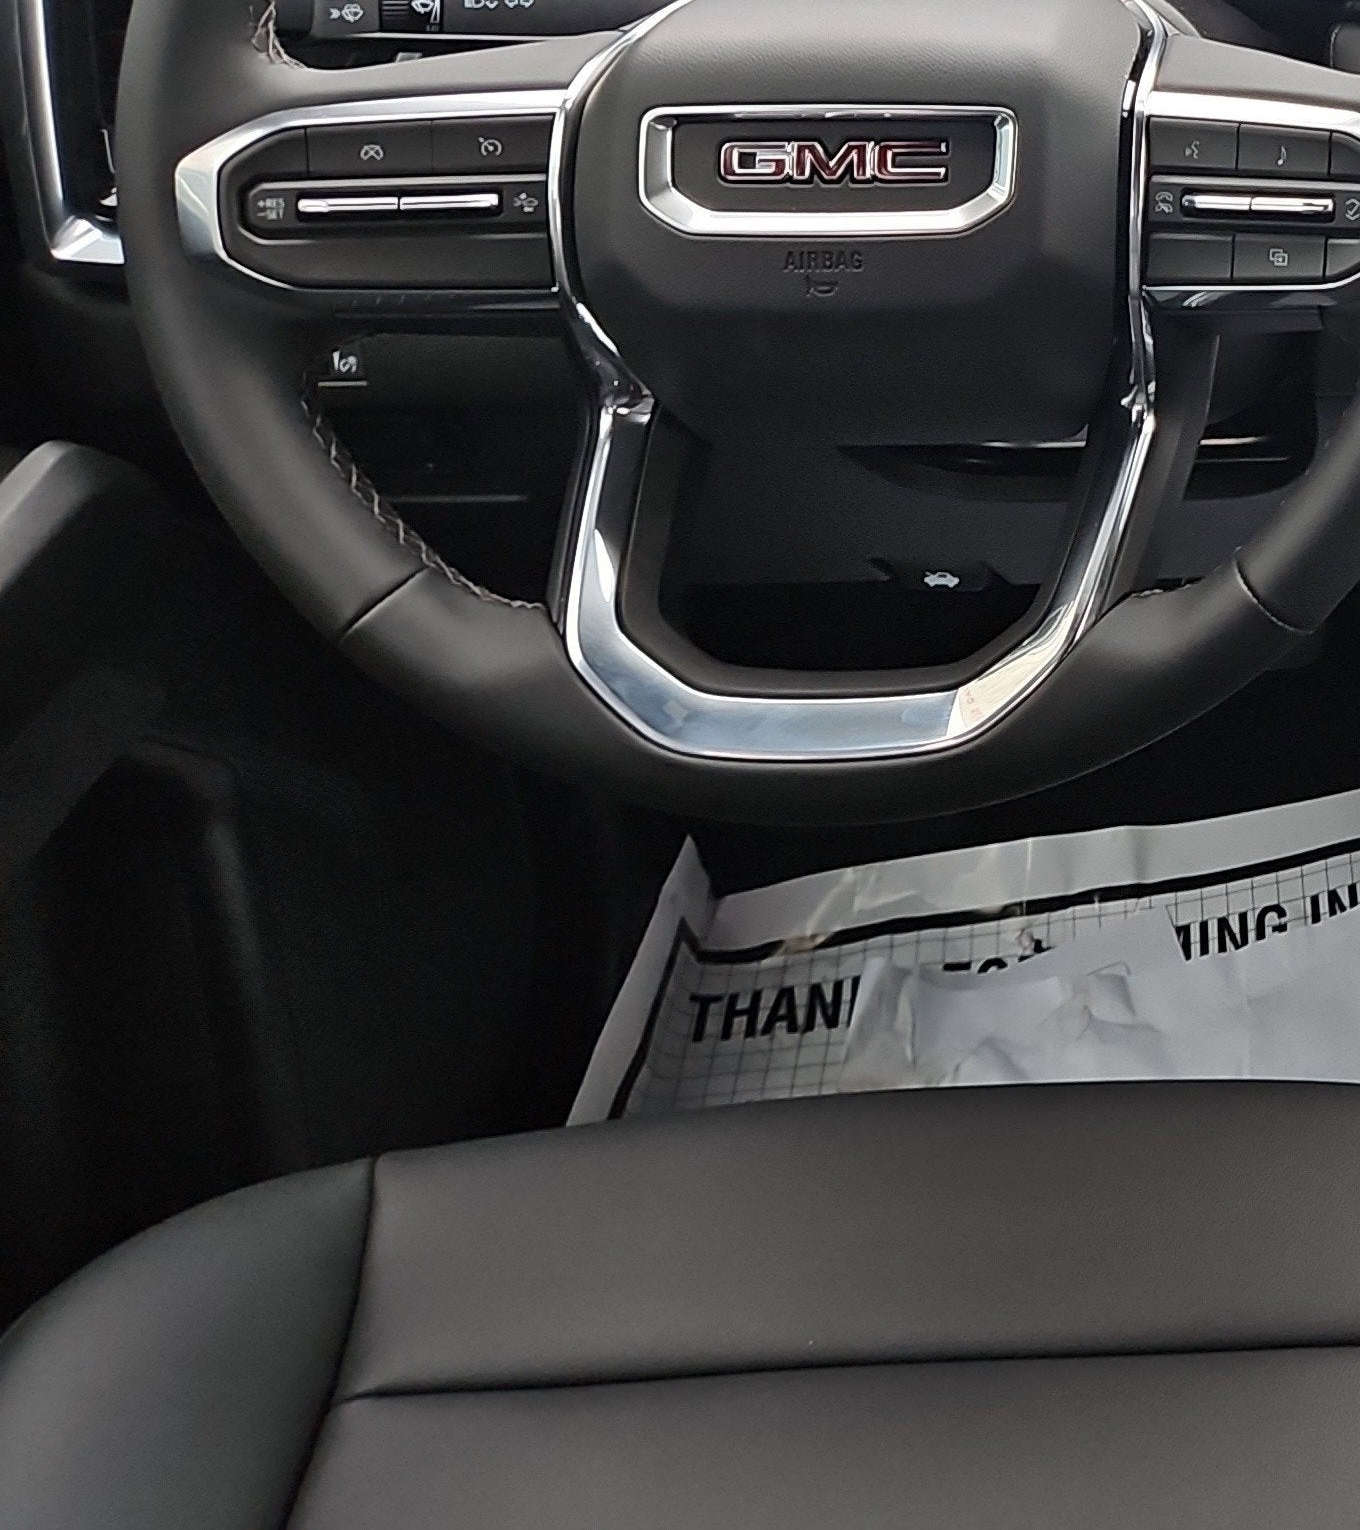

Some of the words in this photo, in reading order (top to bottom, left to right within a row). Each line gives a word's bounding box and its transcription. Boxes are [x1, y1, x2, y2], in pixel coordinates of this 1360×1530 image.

[720, 141, 949, 181] GMC
[783, 251, 864, 272] AIRBAG
[689, 974, 861, 1043] THAN
